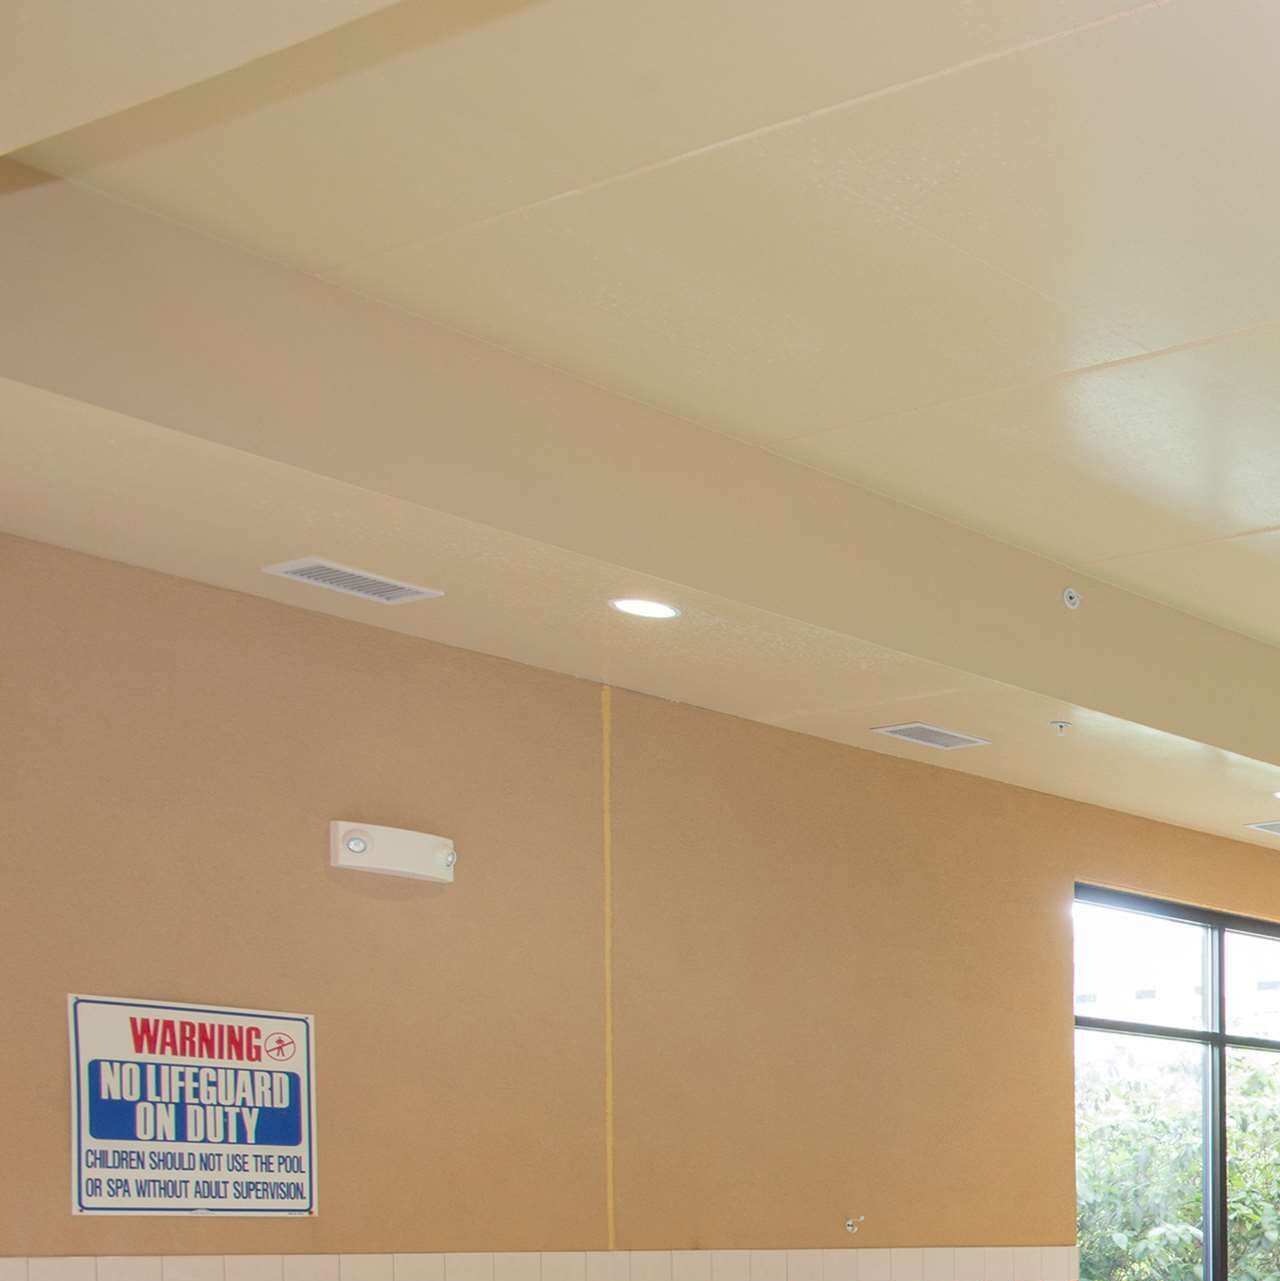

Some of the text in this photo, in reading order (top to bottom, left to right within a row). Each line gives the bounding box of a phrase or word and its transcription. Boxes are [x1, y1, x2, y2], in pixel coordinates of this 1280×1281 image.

[129, 1016, 262, 1062] WARNING
[100, 1060, 290, 1109] NO LIFEGUARD
[136, 1101, 260, 1144] ON DUTY
[85, 1149, 306, 1174] CHILDREN SHOULD NOT USE THE POOL
[85, 1178, 307, 1200] OR SPA WITHOUT ADULT SUPERVISION.
